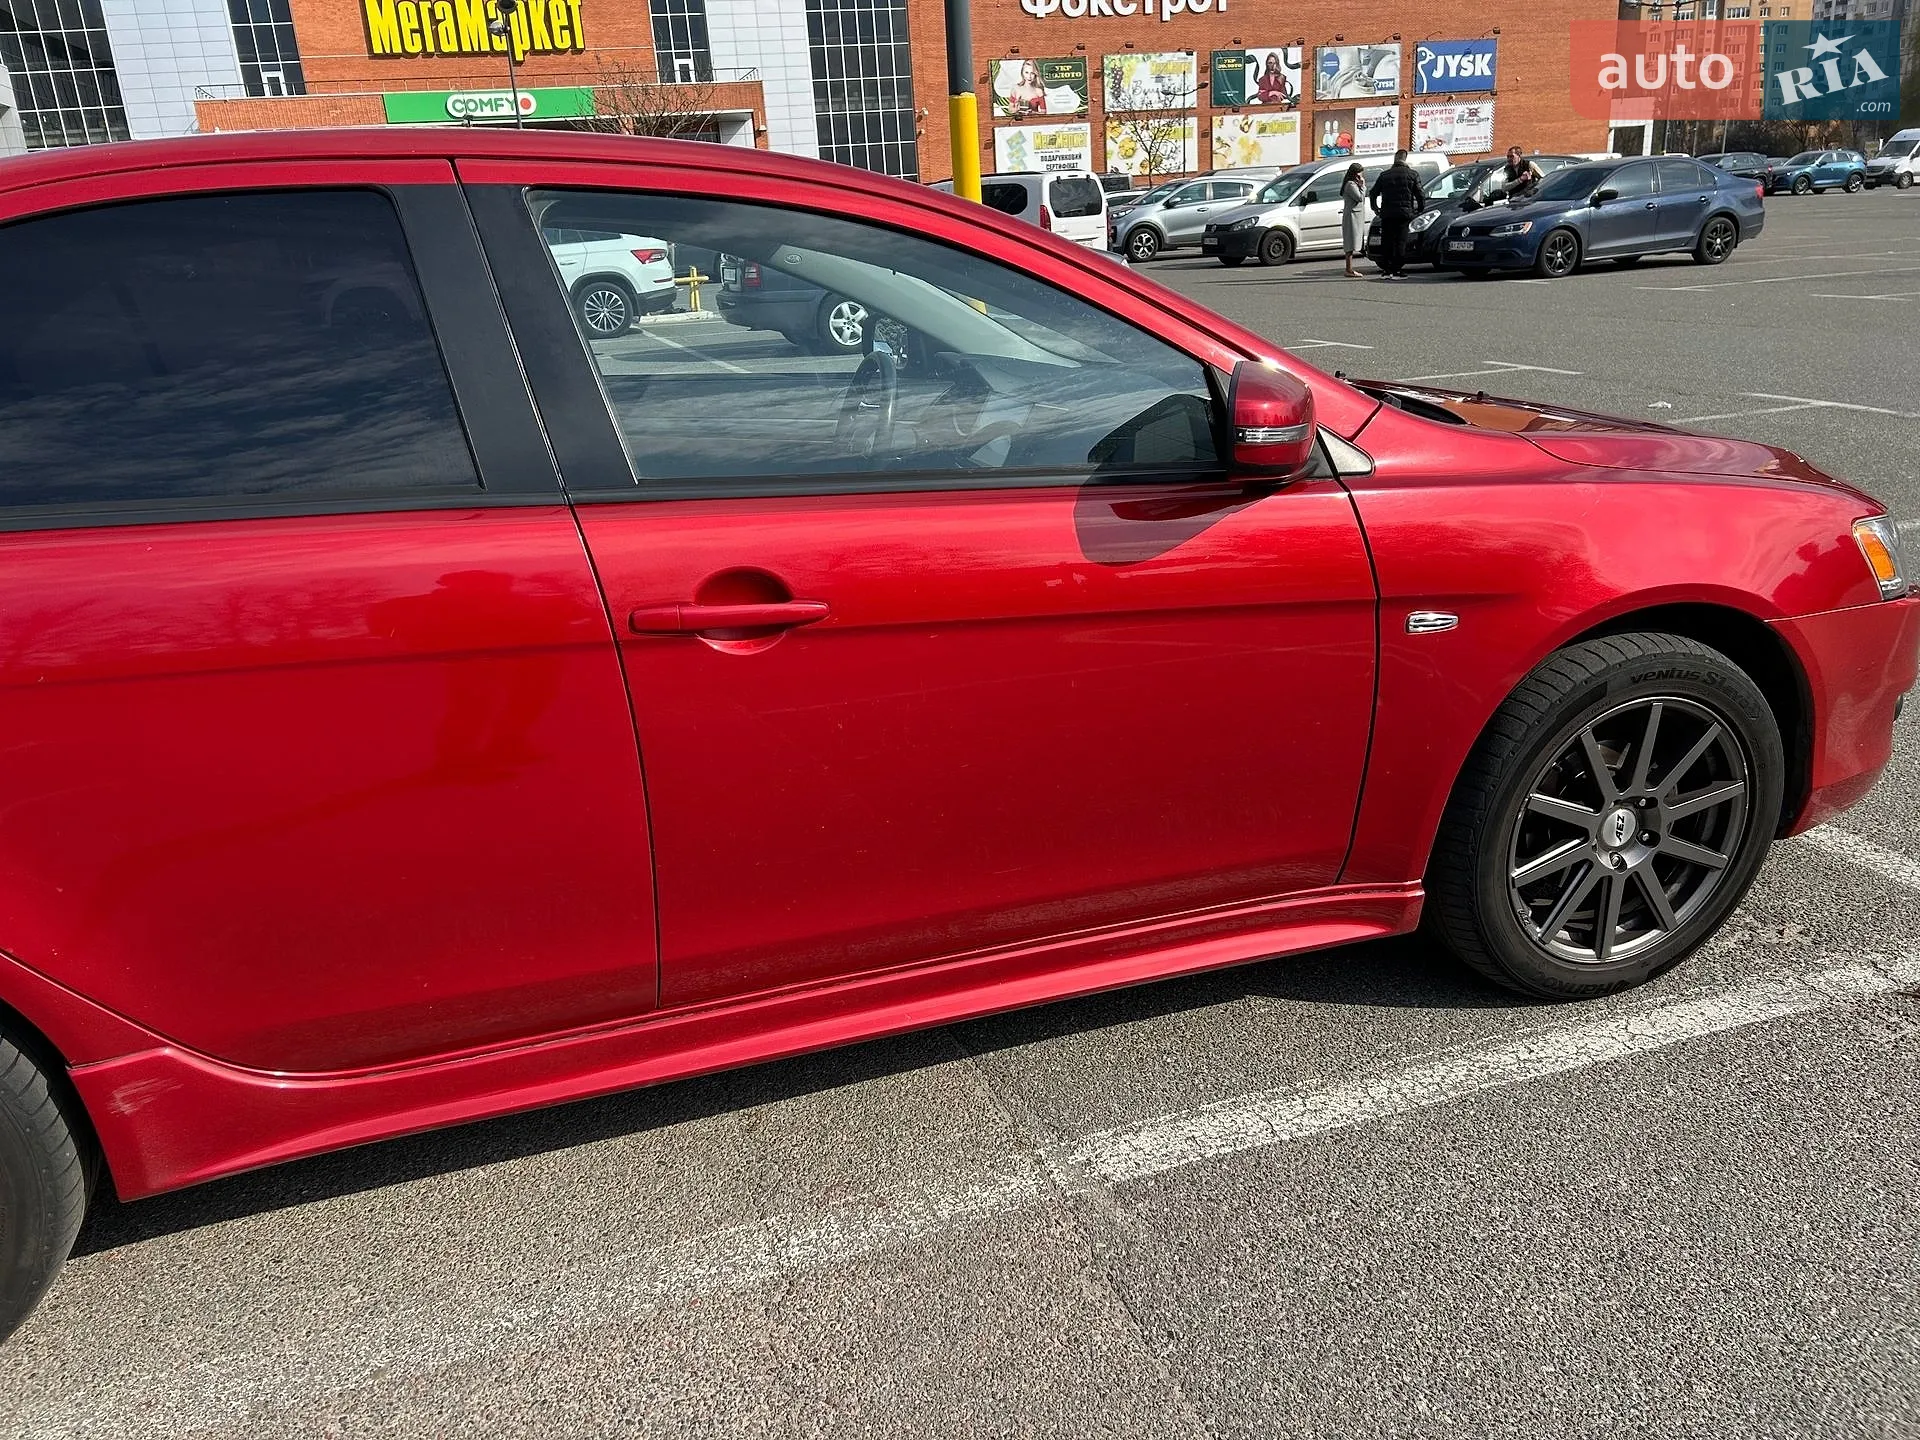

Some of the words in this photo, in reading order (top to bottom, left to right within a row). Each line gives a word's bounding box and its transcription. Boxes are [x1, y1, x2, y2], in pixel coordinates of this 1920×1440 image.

[365, 0, 585, 61] МегаМаркет
[1432, 53, 1493, 78] JYSK
[452, 97, 517, 113] COMFY
[1615, 814, 1625, 842] AEZ
